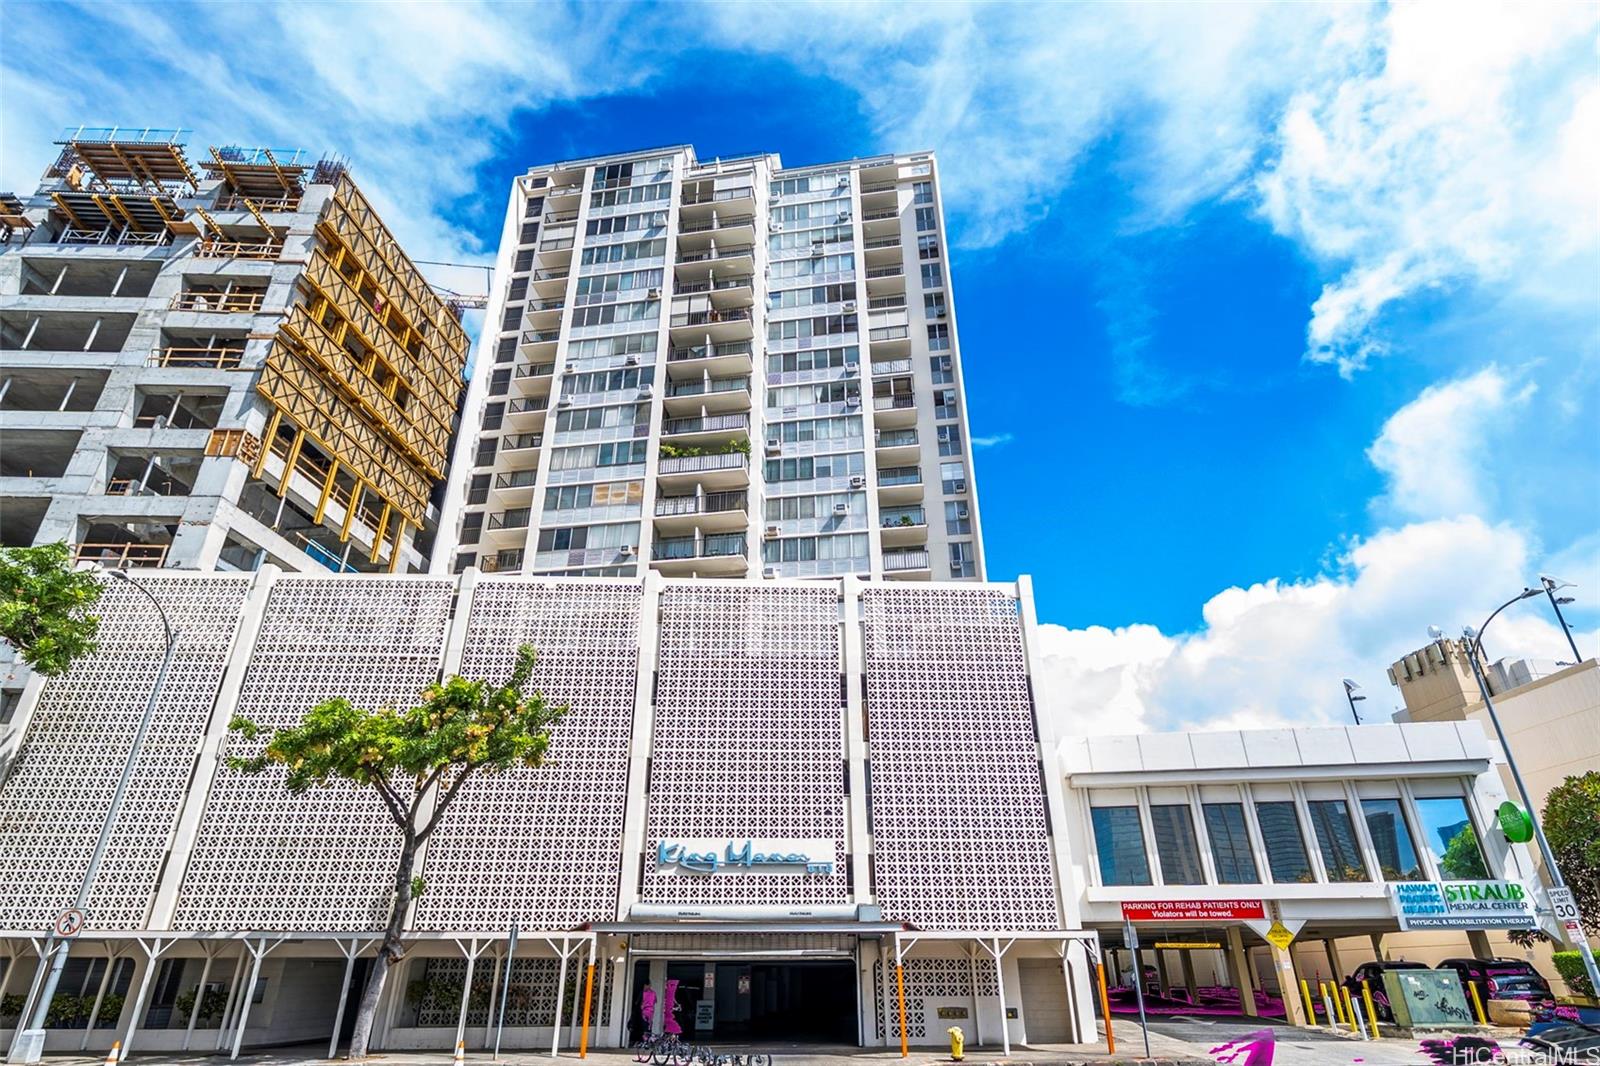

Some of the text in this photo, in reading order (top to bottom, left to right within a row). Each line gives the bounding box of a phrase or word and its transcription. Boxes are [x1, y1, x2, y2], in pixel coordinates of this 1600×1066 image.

[657, 840, 811, 872] King Manor
[1445, 884, 1525, 901] STRAUB
[1399, 894, 1441, 903] PACIFIC
[1122, 902, 1157, 910] PARKING
[1175, 901, 1201, 909] REHAB
[1202, 901, 1240, 909] PATIENTS
[1240, 901, 1260, 909] ONLY
[1402, 905, 1445, 914] HEALTH
[1449, 901, 1529, 911] MEDICAL CENTER
[1209, 909, 1235, 917] towed.
[1555, 904, 1576, 917] 30
[1448, 918, 1502, 926] REHABILITATION
[1502, 917, 1534, 925] THERAPY
